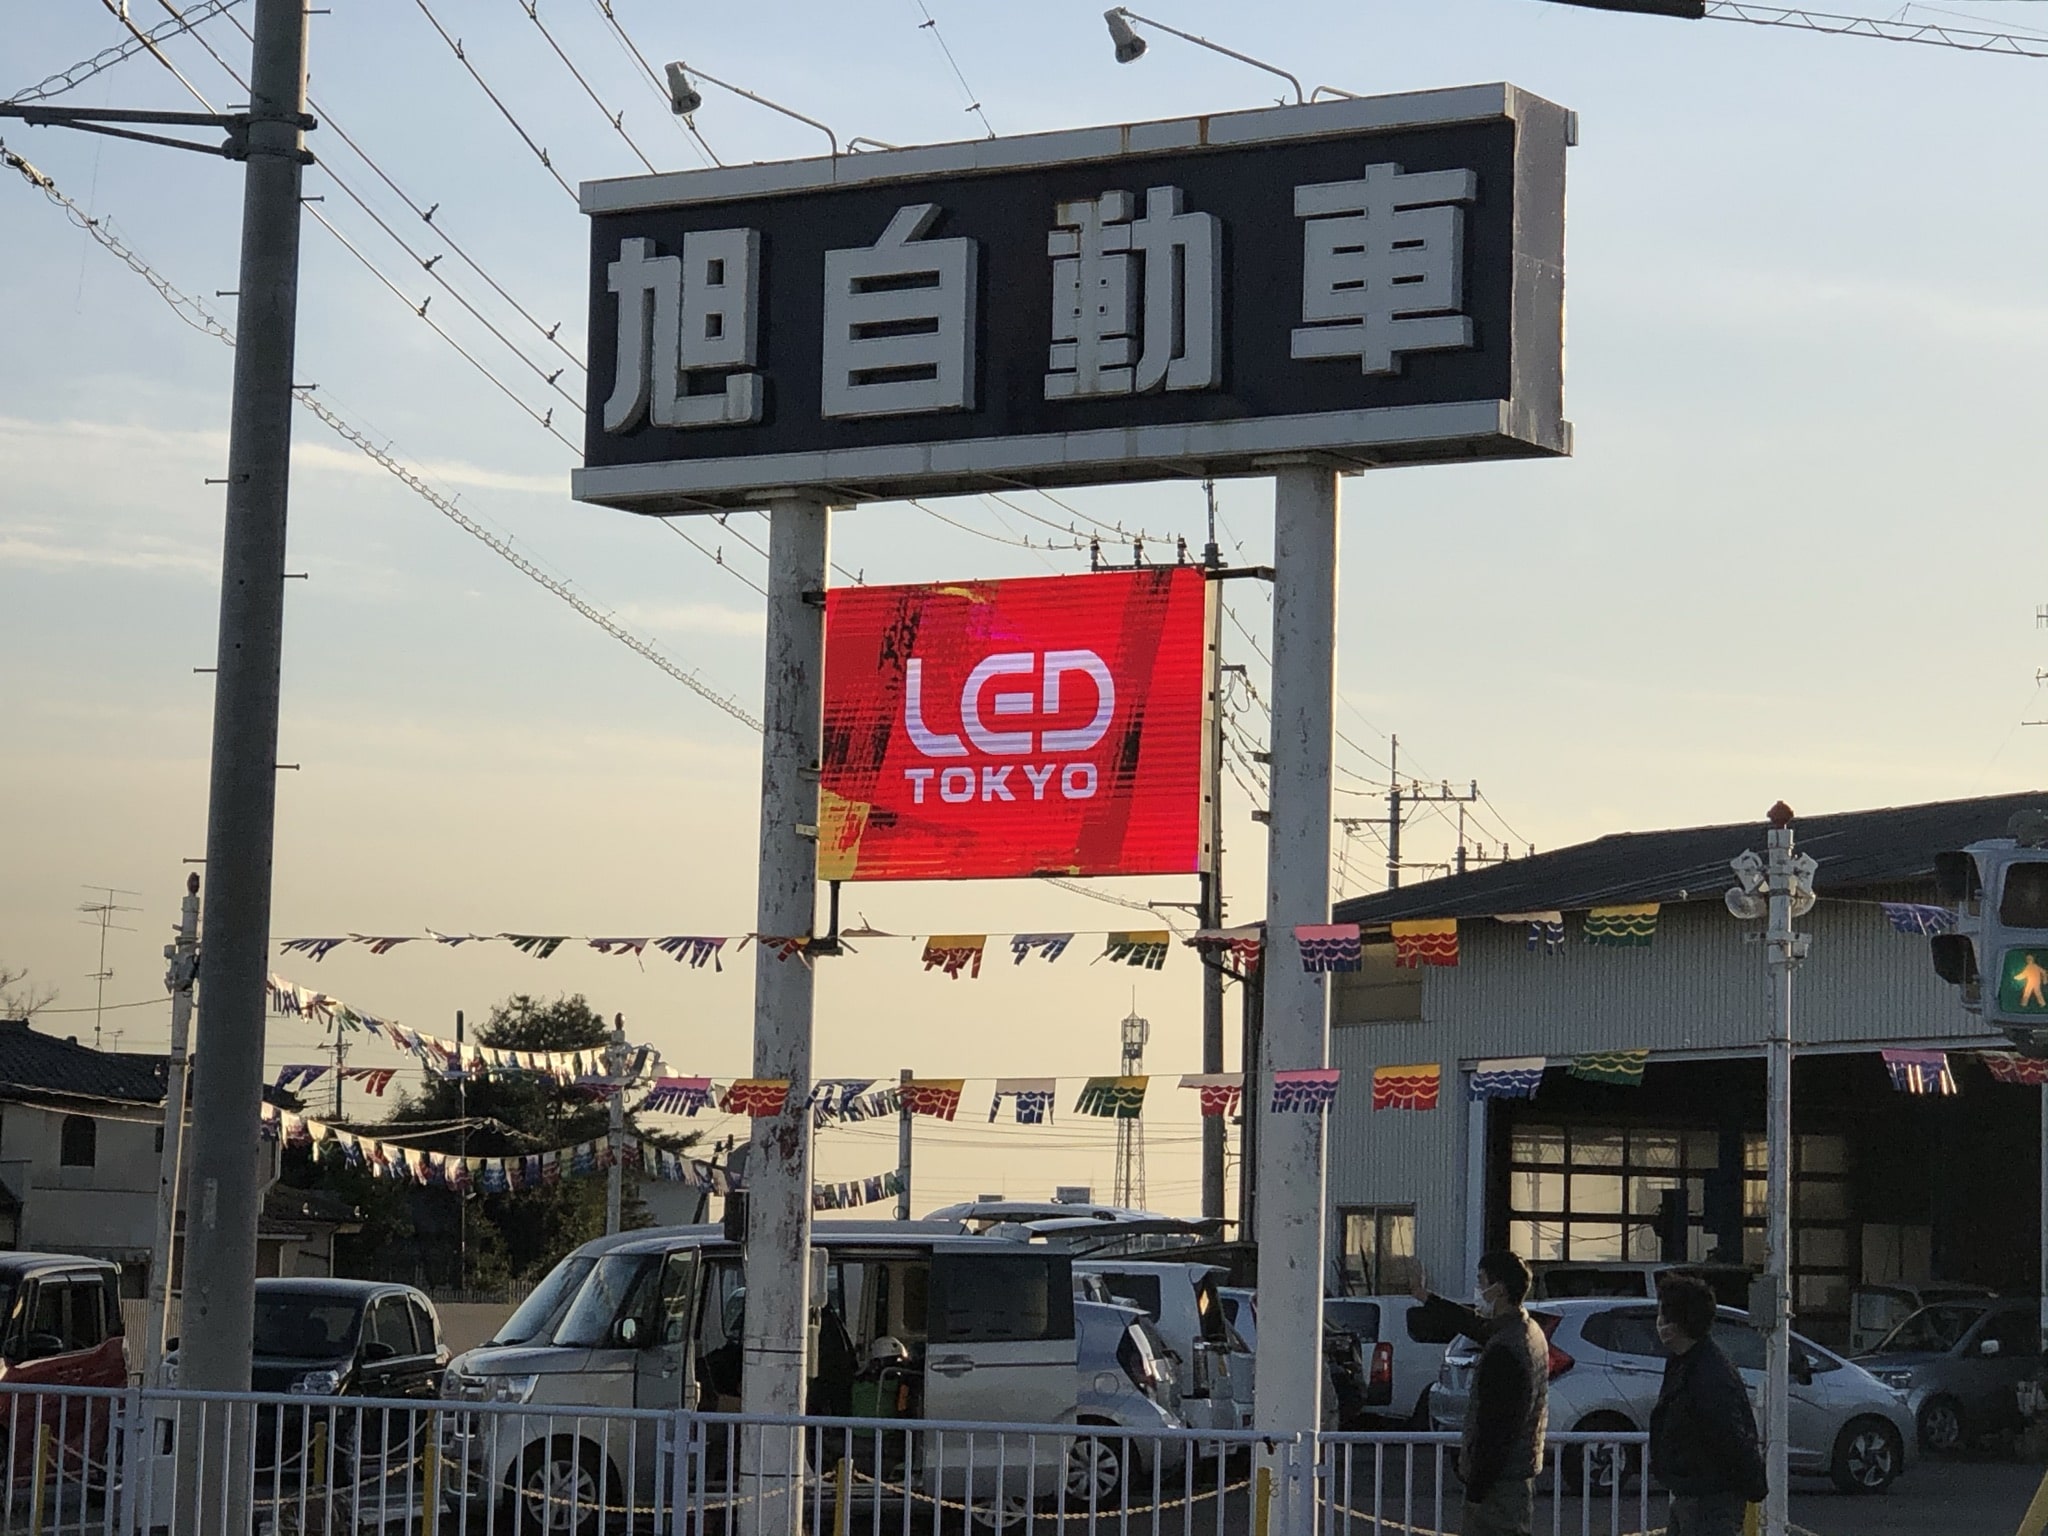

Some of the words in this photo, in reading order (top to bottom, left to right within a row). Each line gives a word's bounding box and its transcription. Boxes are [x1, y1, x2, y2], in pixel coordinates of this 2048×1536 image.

[604, 162, 1477, 434] 旭自動車
[905, 649, 1115, 758] LED
[904, 762, 1098, 804] TOKYO
